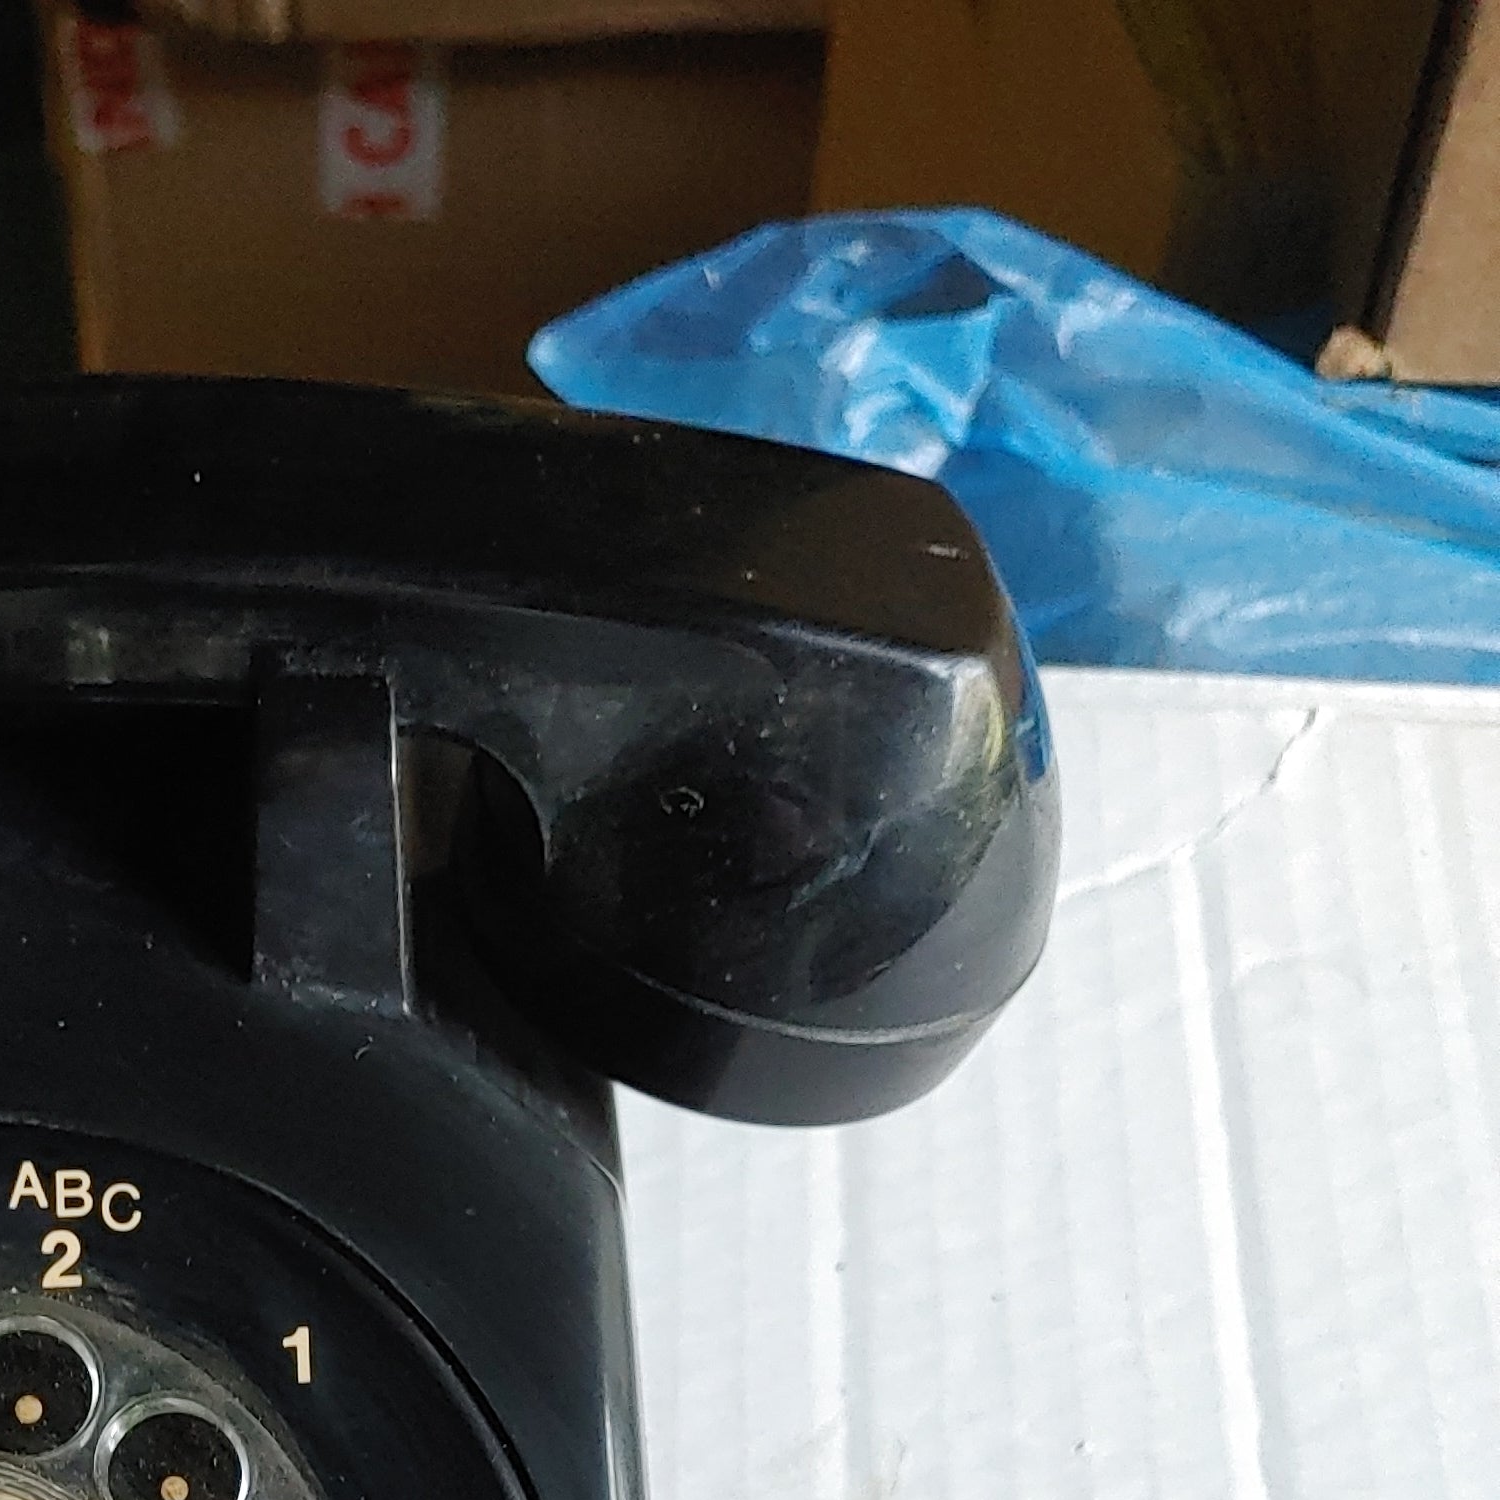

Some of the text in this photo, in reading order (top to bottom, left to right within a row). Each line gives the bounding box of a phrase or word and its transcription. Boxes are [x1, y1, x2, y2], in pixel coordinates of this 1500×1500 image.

[9, 1161, 144, 1234] ABC
[41, 1230, 83, 1289] 2
[283, 1326, 311, 1384] 1
